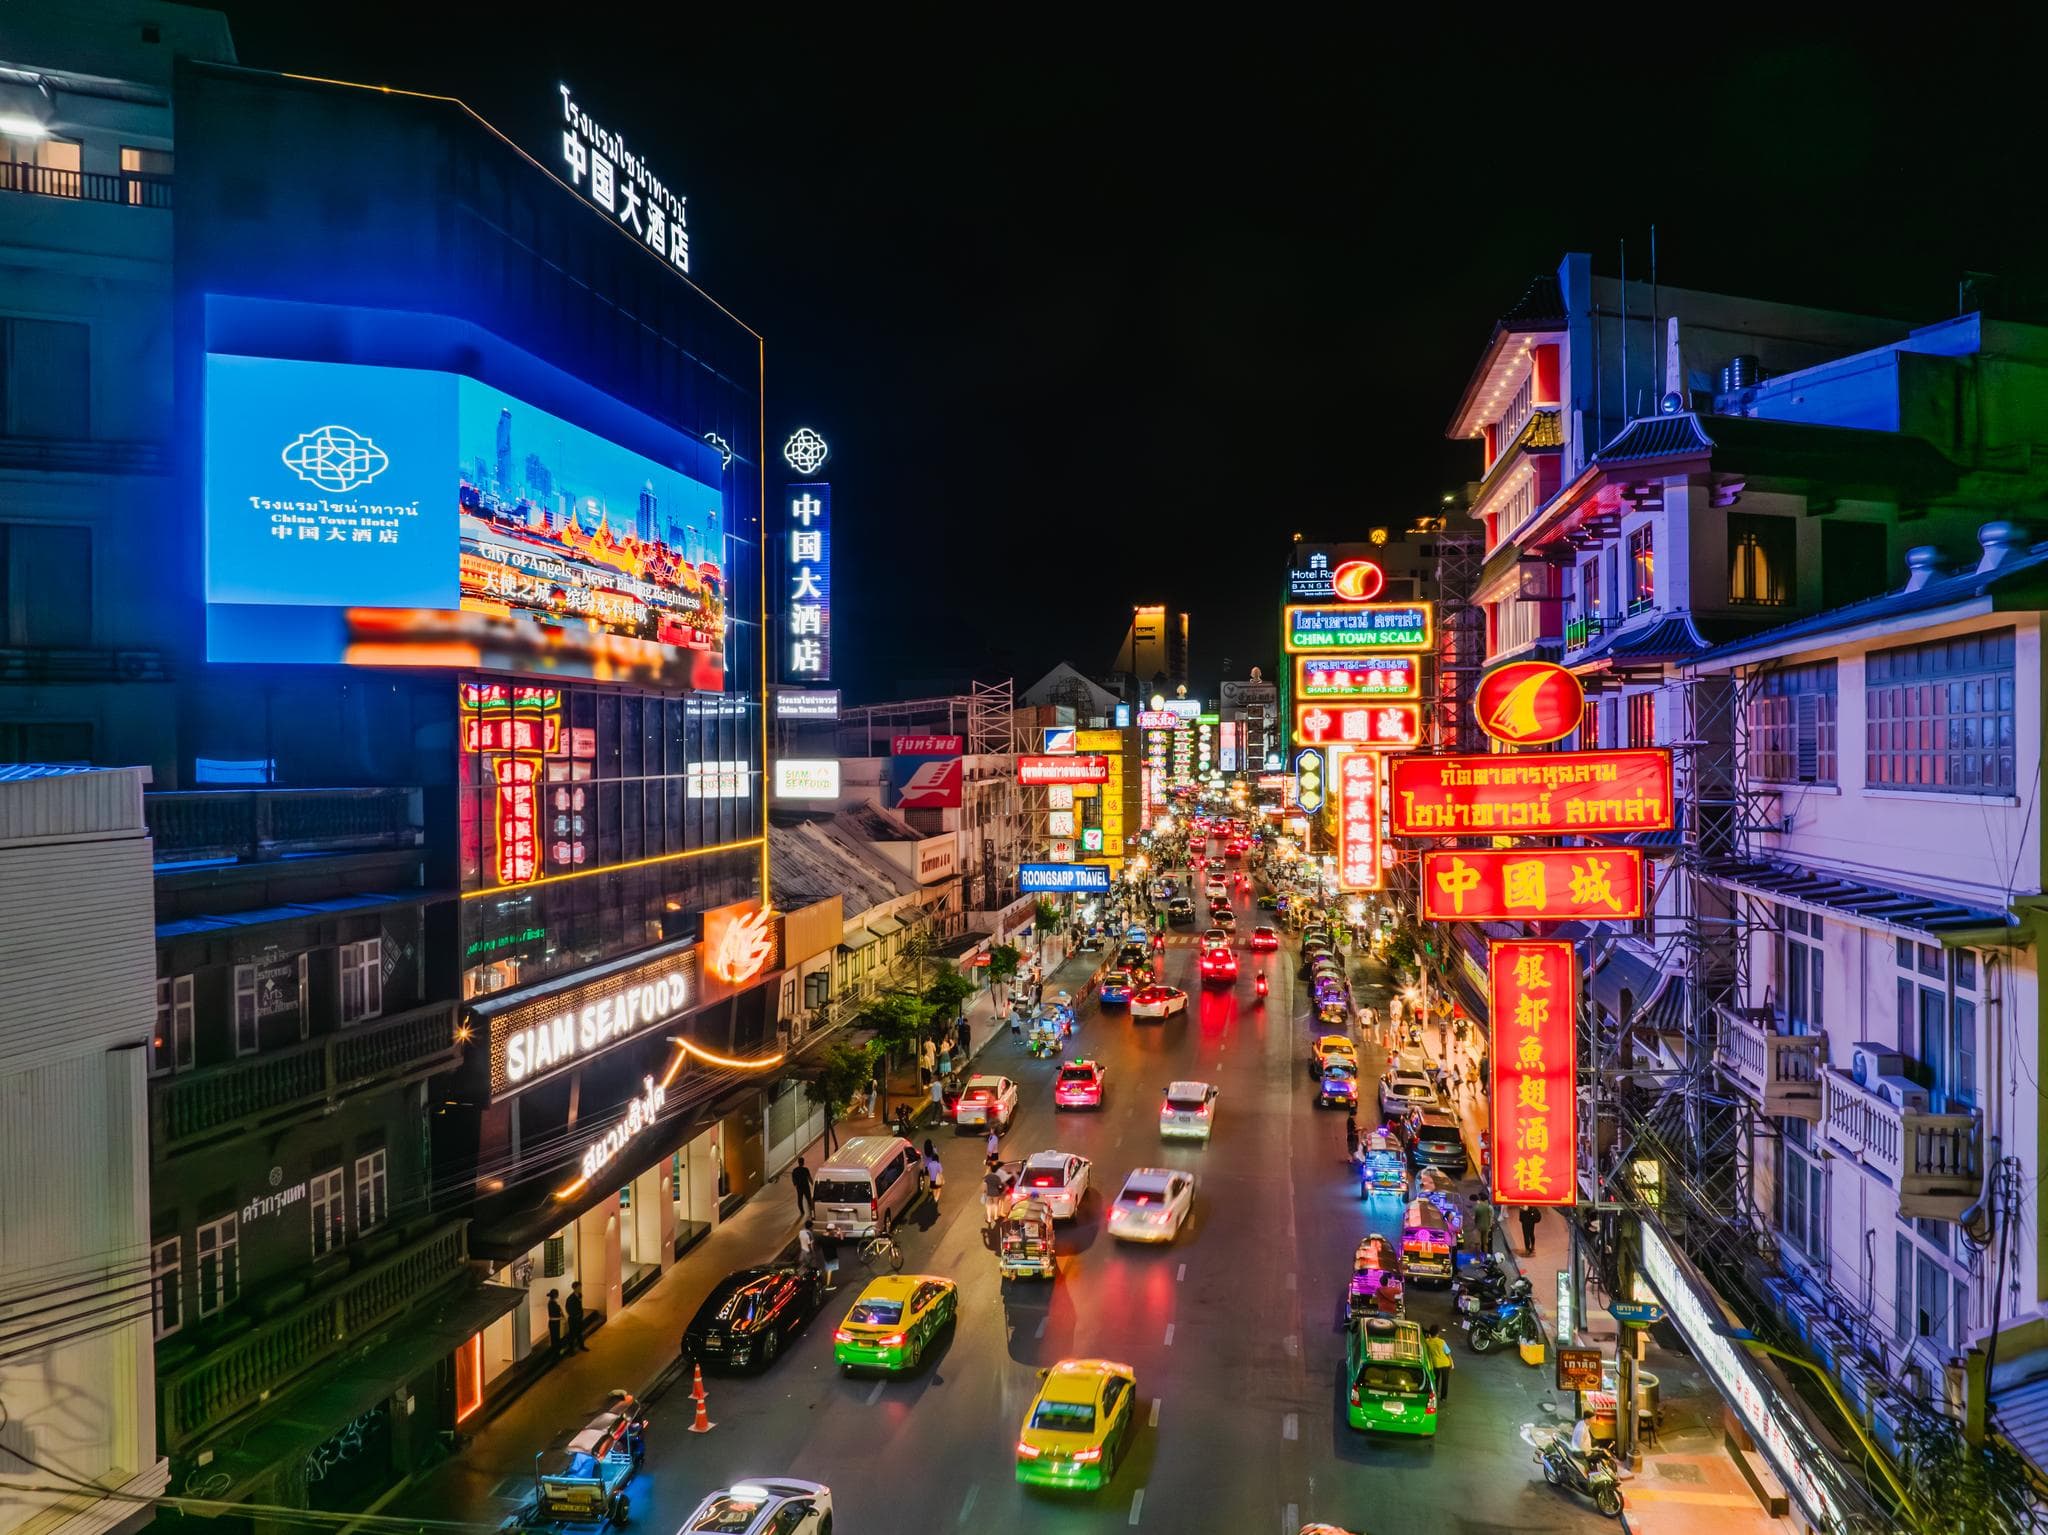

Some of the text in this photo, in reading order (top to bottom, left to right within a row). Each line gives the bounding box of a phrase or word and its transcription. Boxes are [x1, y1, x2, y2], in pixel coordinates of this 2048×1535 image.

[559, 84, 687, 228] โรงแรมไชน่าทาวน์
[562, 129, 689, 273] 中国大酒店
[249, 496, 419, 516] โรงแรมไชน่าทาวน์
[271, 514, 399, 527] China Town Hotel
[271, 525, 399, 544] 中国大酒店
[480, 543, 509, 566] City
[511, 552, 528, 569] of
[582, 569, 615, 588] Never
[616, 577, 652, 600] Ending
[652, 586, 701, 609] Brightness
[791, 493, 822, 672] 中国大酒店
[1291, 570, 1334, 579] Hotel Ro
[1292, 582, 1331, 590] BANGK
[1293, 632, 1423, 645] CHINA TOWN SCALA
[1307, 686, 1338, 694] SHARK'S
[1389, 685, 1408, 693] NEST
[1304, 708, 1409, 742] 中國城
[896, 736, 959, 755] รุ่งทรัพย์
[785, 769, 809, 779] SIAM
[1400, 787, 1661, 827] ไชน่าทาวน์ สกาล่า
[1022, 870, 1108, 886] ROONGSARP TRAVEL
[1437, 857, 1622, 913] 中國城
[507, 974, 686, 1080] SIAM SEAFOOD
[1512, 954, 1552, 1195] 銀都魚翅酒樓
[1650, 1307, 1658, 1317] 2
